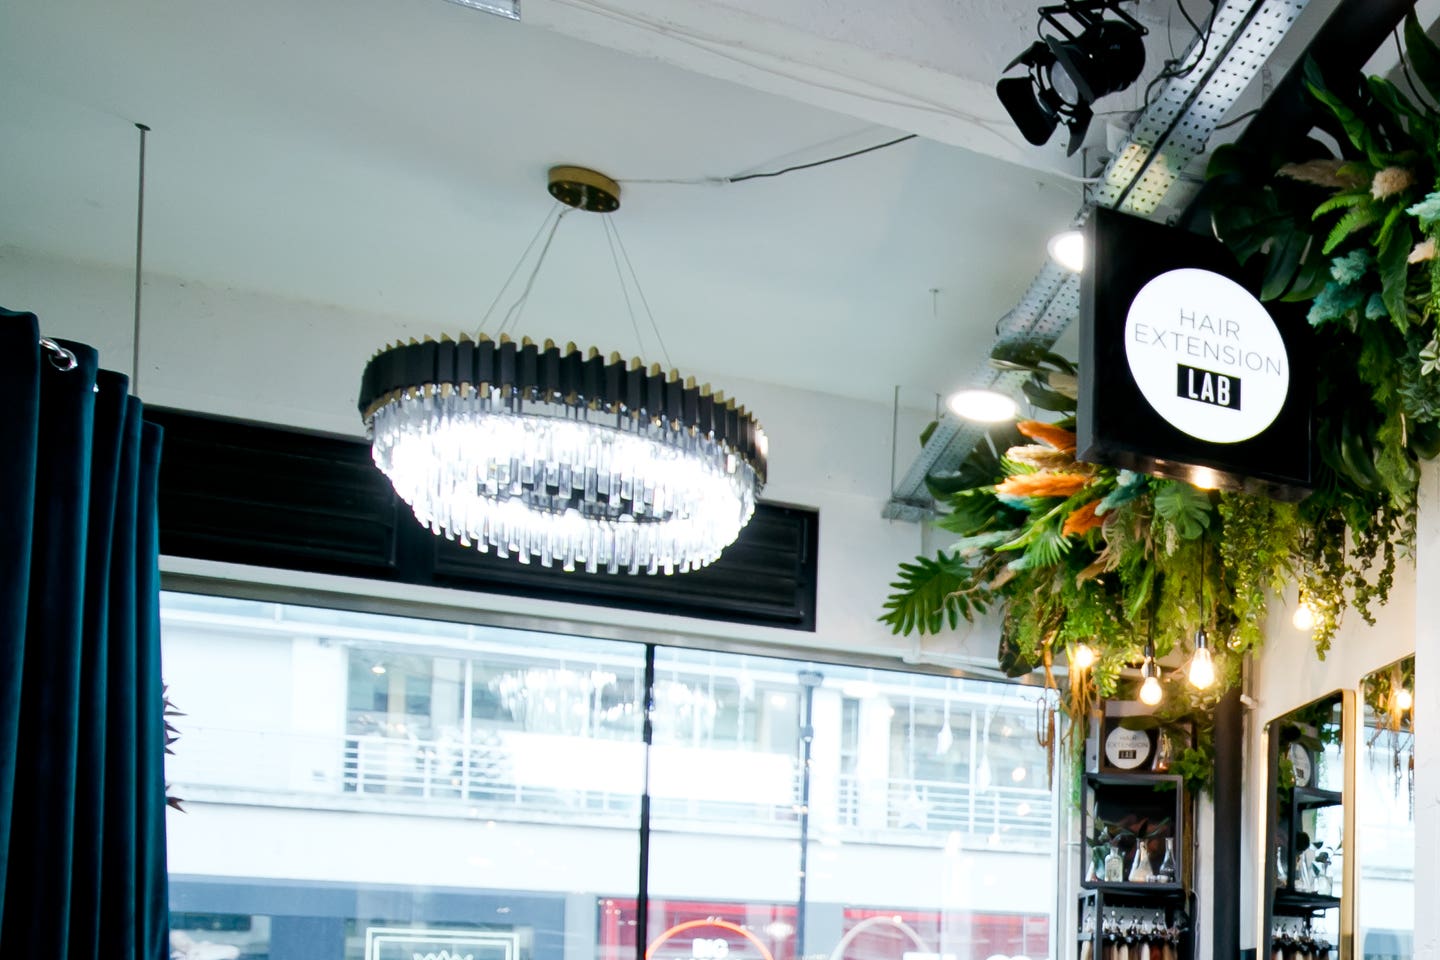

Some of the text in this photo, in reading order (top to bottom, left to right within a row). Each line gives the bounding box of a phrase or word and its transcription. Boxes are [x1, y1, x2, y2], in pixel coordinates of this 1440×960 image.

[1179, 307, 1240, 341] HAIR
[1134, 322, 1282, 376] EXTENSION
[1188, 368, 1231, 406] LAB
